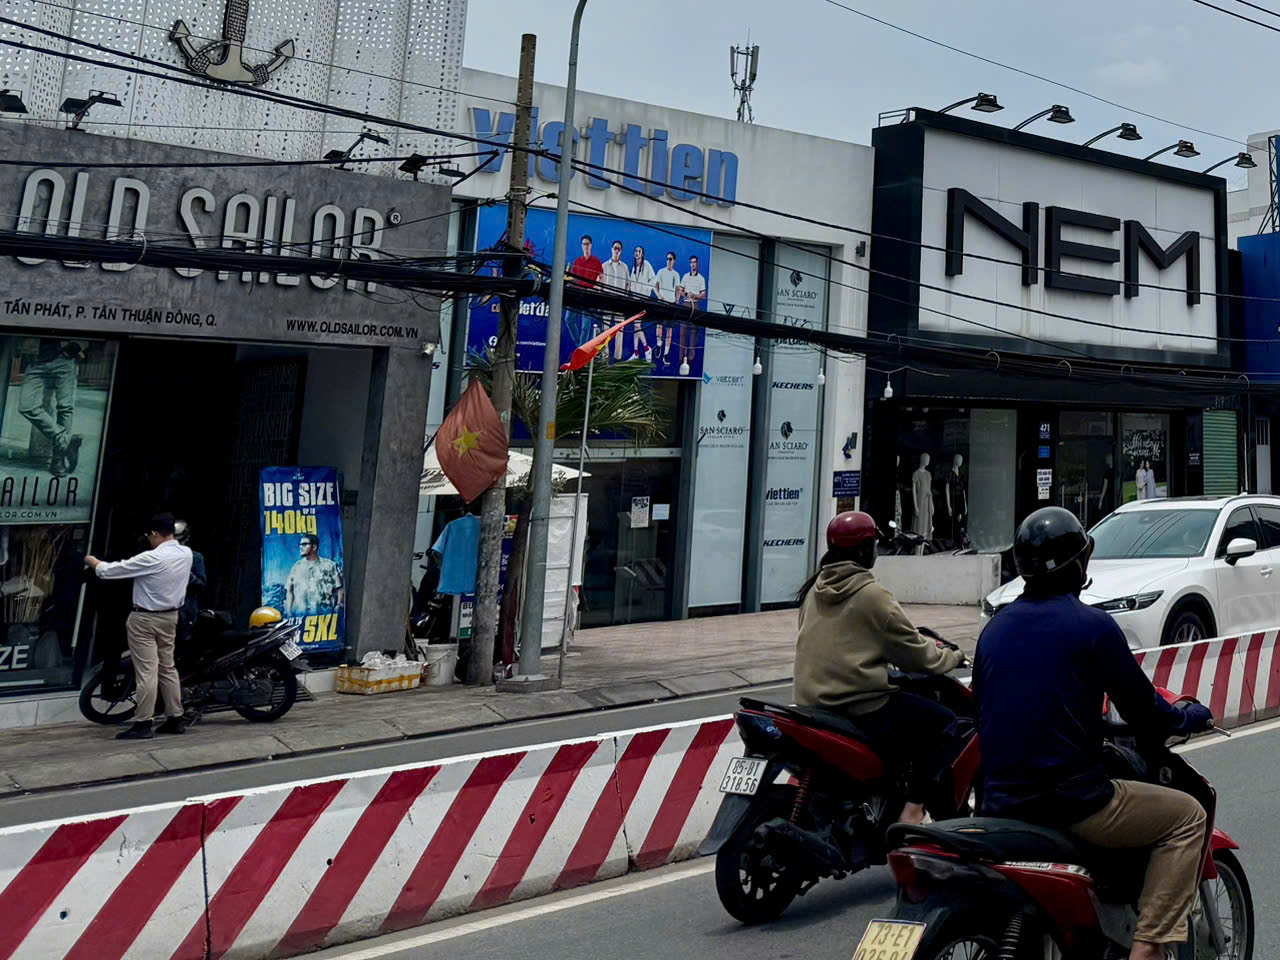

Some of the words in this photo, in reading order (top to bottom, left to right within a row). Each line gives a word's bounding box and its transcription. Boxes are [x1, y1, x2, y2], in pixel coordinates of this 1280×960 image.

[15, 168, 151, 272] OLD
[945, 187, 1201, 307] NEM
[4, 297, 31, 315] TẤN
[34, 301, 71, 320] PHÁT,
[76, 306, 87, 319] P.
[92, 305, 117, 321] TÂN
[121, 308, 162, 325] THUẬN
[206, 314, 217, 327] Q.
[772, 381, 814, 390] KECHERS
[769, 442, 780, 450] AN
[263, 482, 294, 507] BIG
[298, 482, 335, 506] SIZE
[264, 510, 317, 535] 140kg
[763, 538, 805, 547] KECHERS
[722, 775, 758, 793] 318.56
